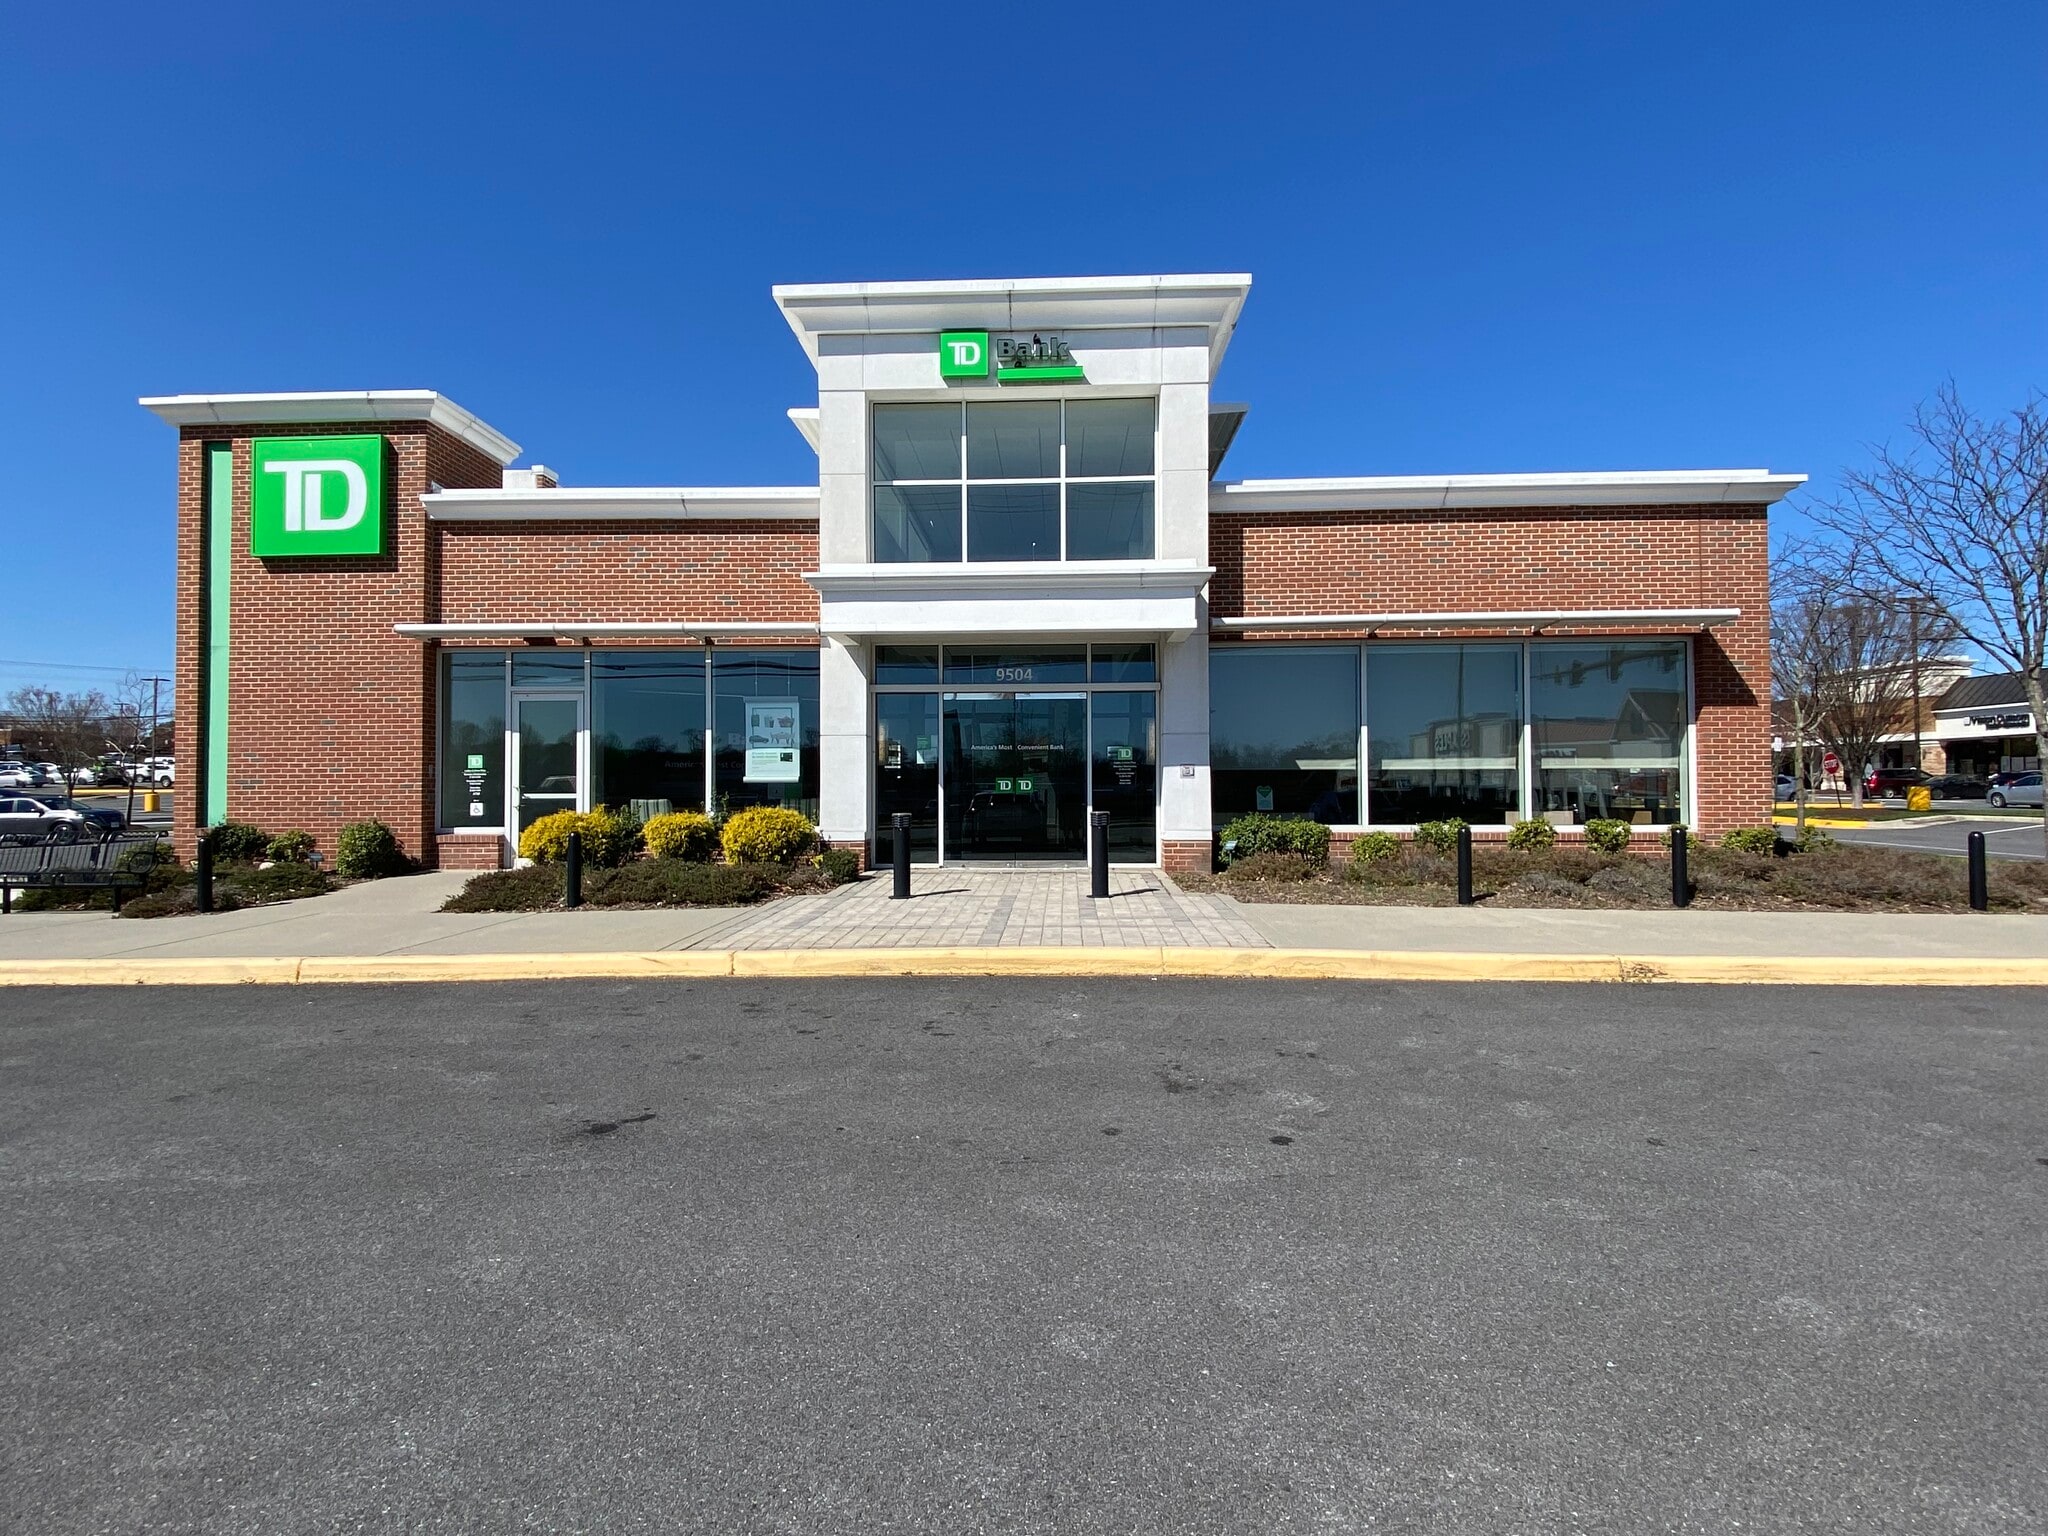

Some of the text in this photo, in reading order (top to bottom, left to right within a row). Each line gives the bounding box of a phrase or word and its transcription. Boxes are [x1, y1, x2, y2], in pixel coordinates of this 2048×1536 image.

[947, 336, 1069, 366] TD Bank
[264, 459, 368, 532] TD
[996, 668, 1033, 681] 9504
[997, 780, 1032, 791] TD TD
